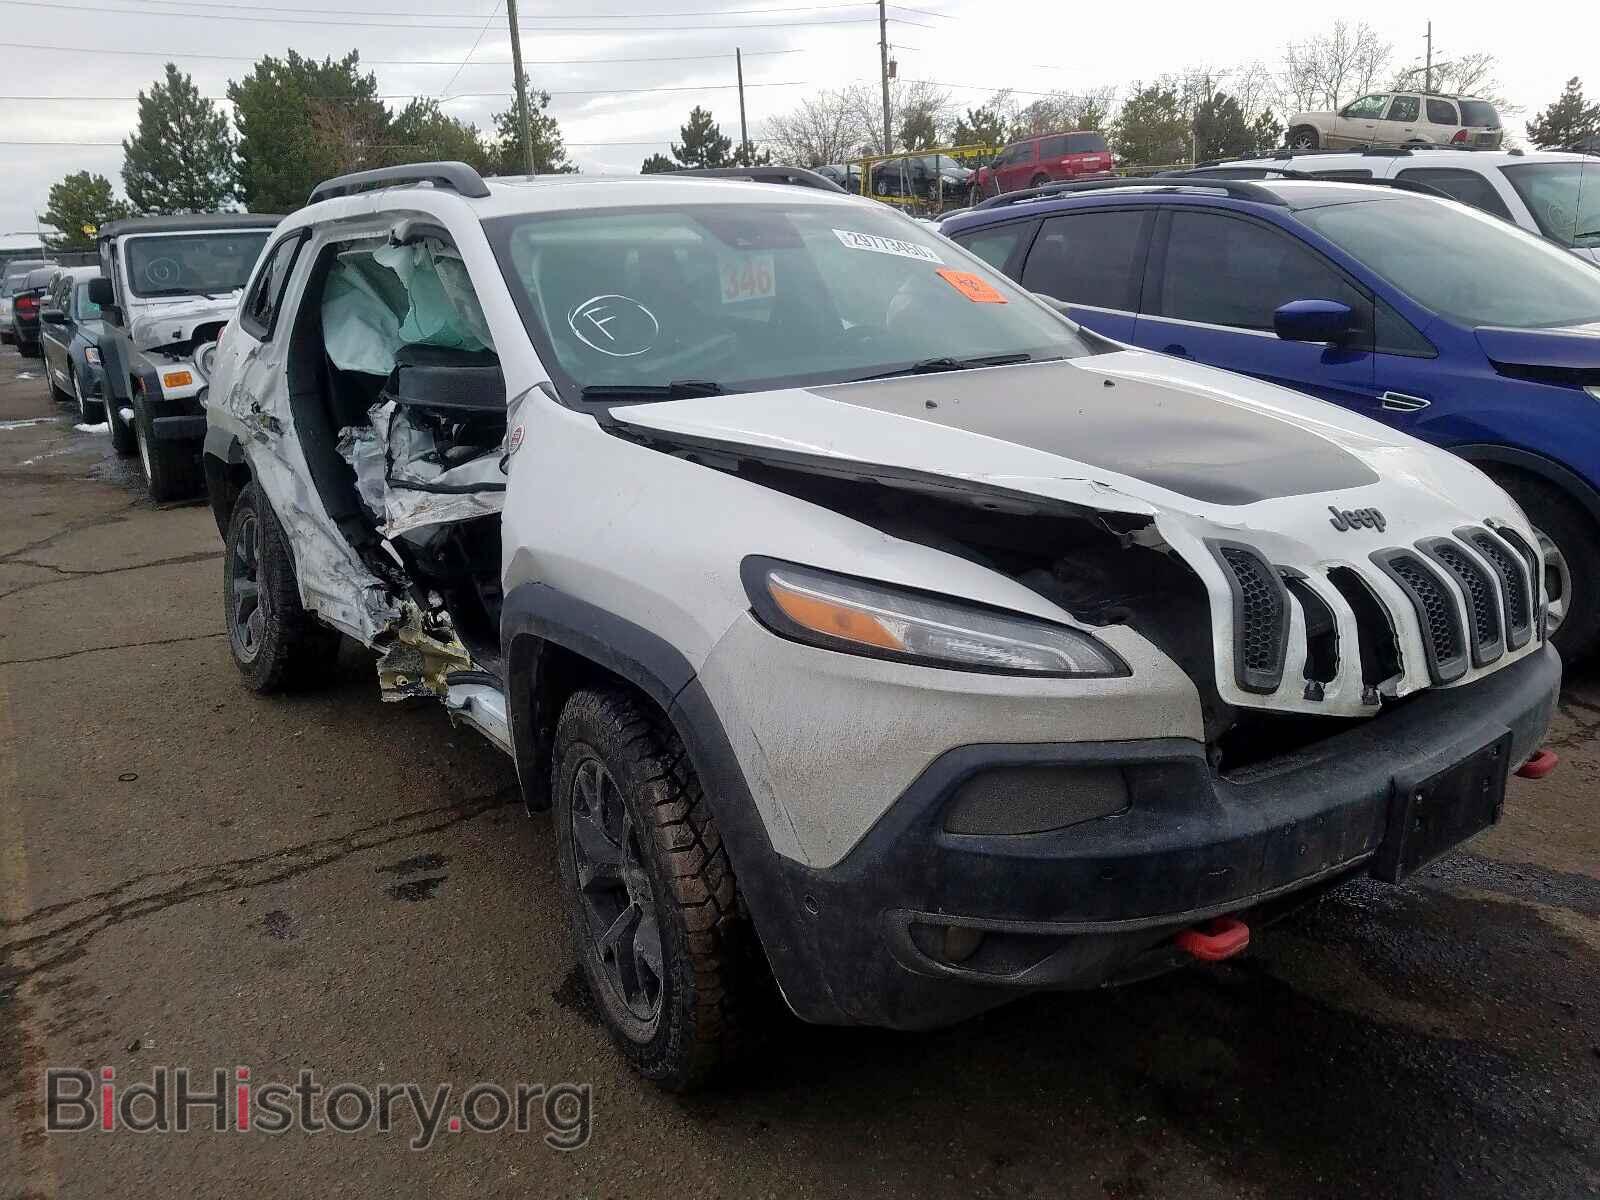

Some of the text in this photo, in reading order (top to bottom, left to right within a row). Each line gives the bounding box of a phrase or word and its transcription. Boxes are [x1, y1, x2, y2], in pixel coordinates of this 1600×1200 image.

[724, 262, 770, 298] 346
[583, 306, 616, 340] F
[1328, 505, 1386, 533] Jeep
